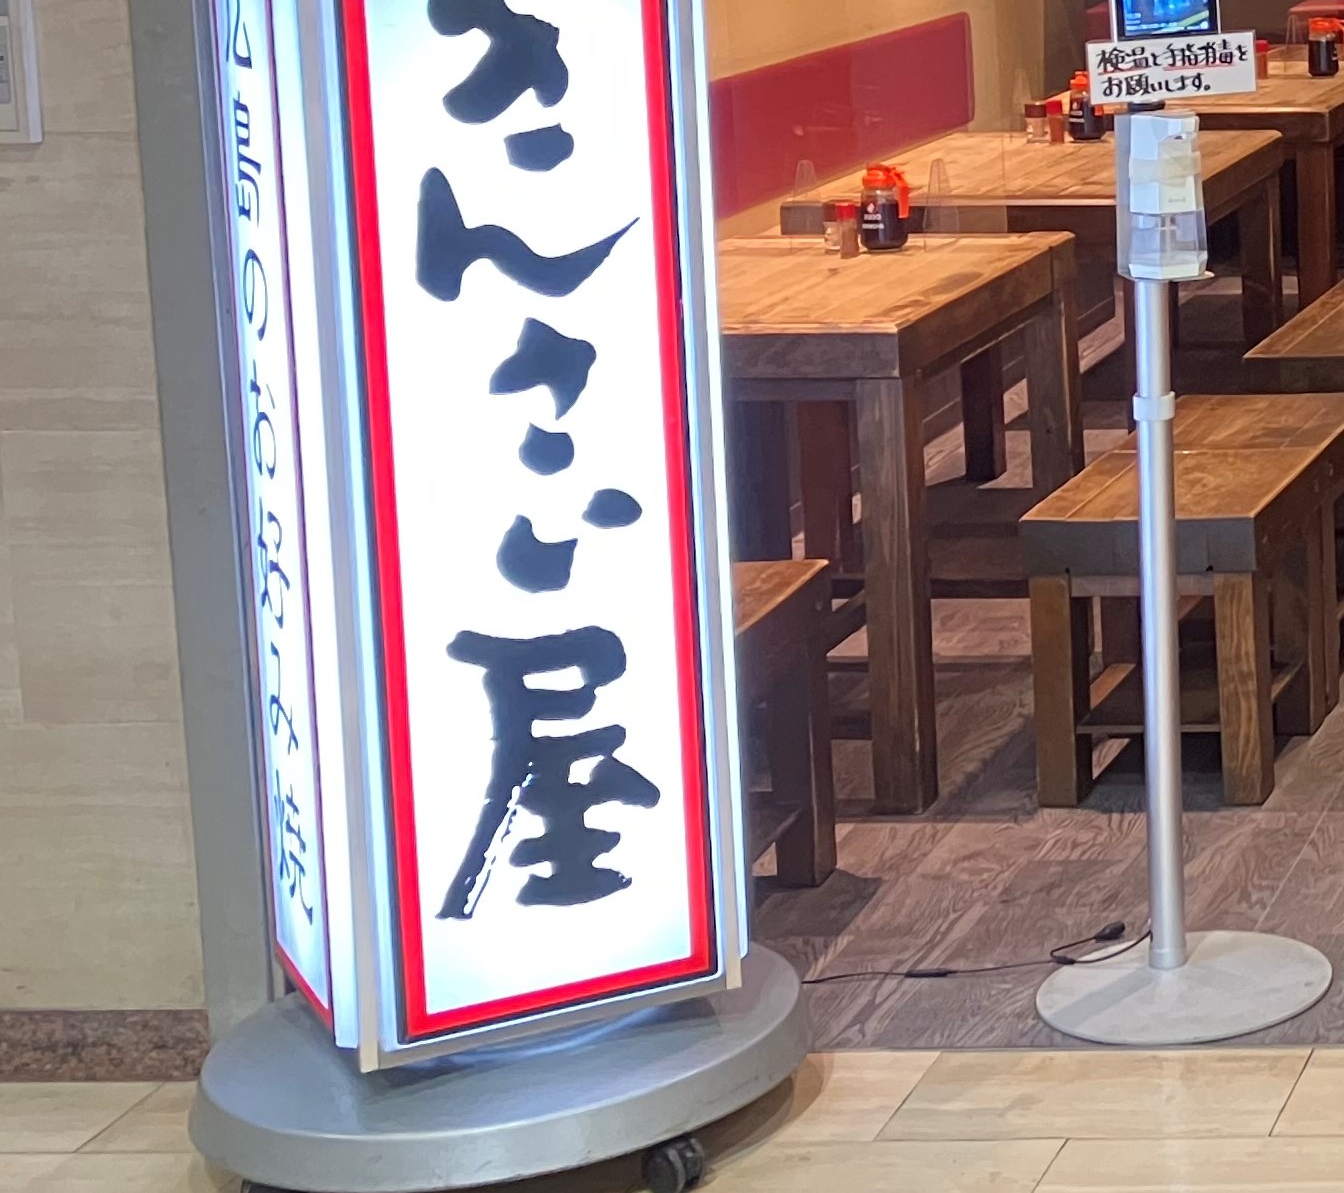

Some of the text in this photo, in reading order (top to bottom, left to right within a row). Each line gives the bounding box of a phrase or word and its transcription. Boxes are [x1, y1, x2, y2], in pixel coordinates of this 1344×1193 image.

[1096, 39, 1249, 73] 検温と手指消毒を
[1101, 72, 1212, 98] お願いします。
